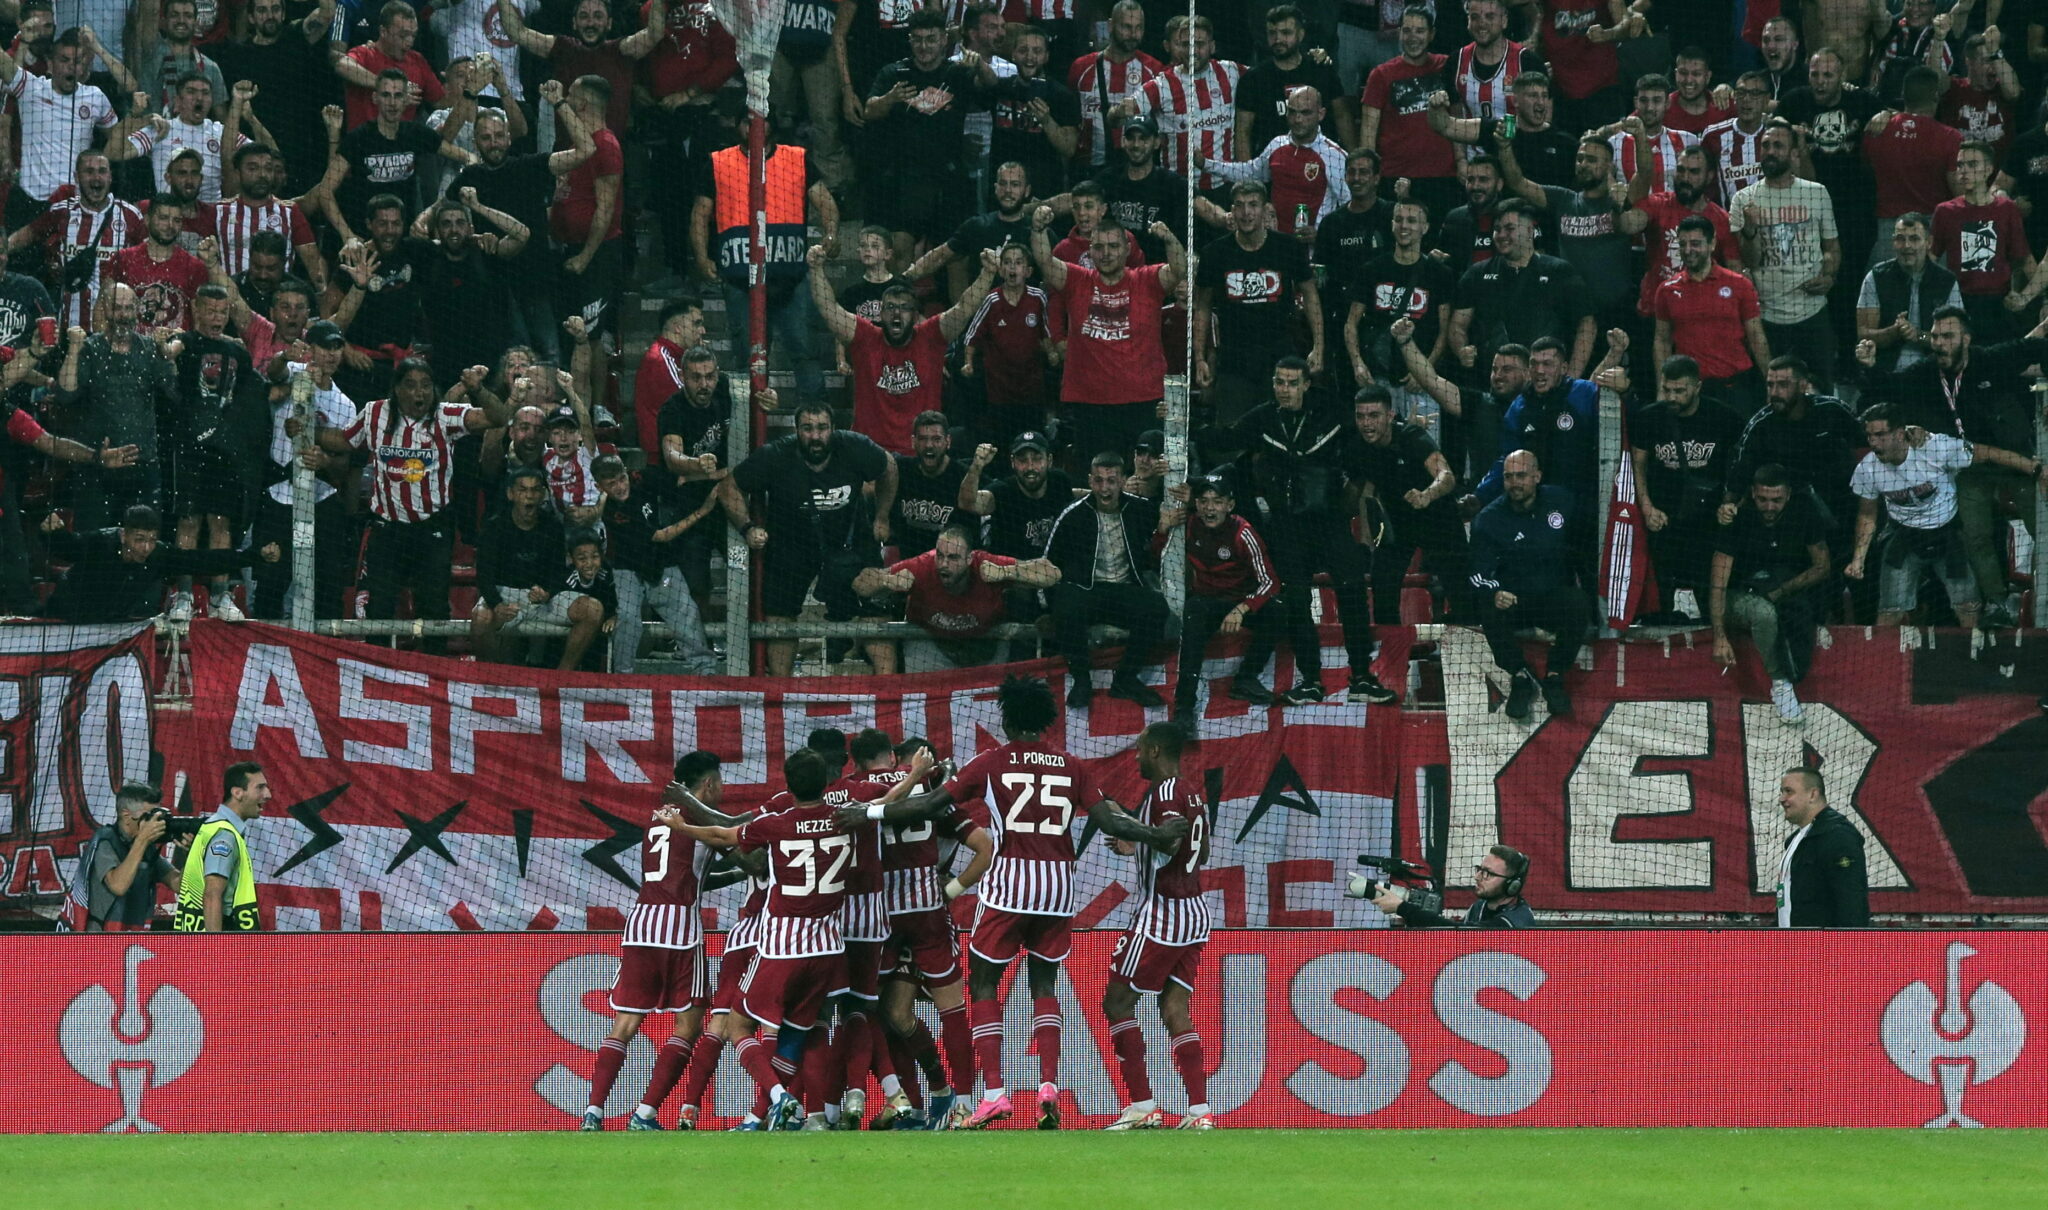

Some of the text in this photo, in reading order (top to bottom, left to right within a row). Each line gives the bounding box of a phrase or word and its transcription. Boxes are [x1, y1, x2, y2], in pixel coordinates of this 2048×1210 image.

[783, 2, 836, 35] WARD
[1081, 324, 1131, 341] FINAL
[1010, 752, 1066, 768] J. POROZO
[796, 818, 834, 834] HEZZE
[1001, 772, 1074, 836] 25
[644, 825, 671, 882] 3
[779, 834, 851, 897] 32
[1185, 814, 1204, 873] 9
